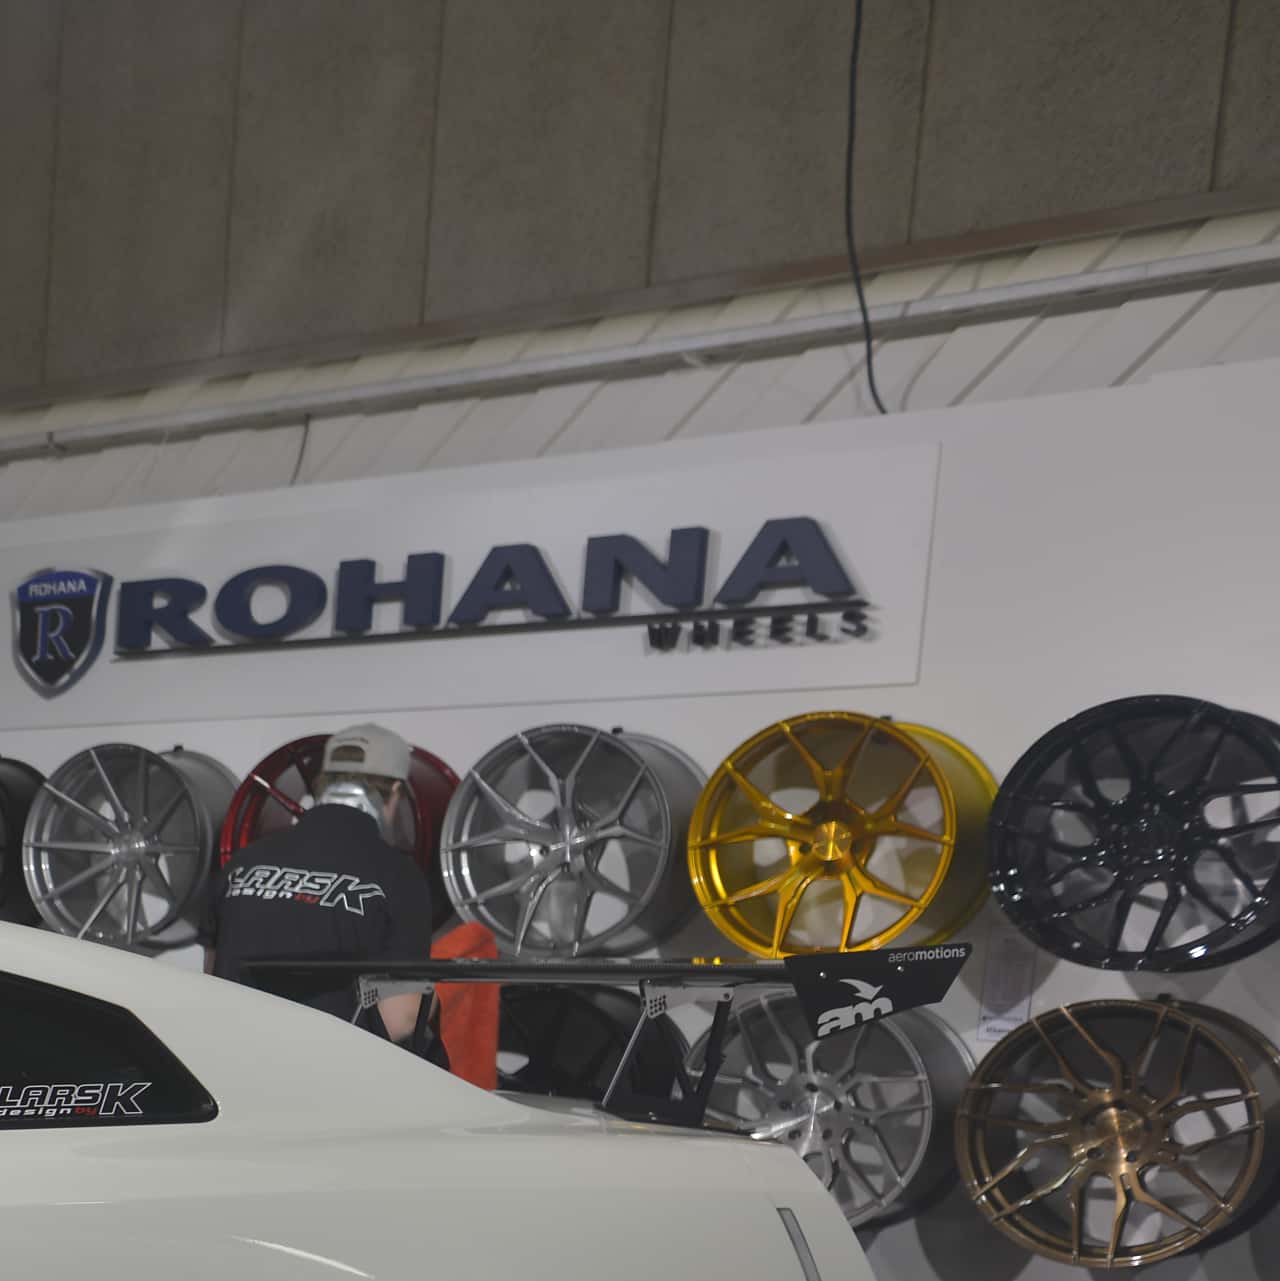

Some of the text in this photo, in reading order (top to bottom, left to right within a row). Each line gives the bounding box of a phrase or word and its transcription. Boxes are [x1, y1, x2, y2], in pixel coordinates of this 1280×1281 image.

[29, 577, 88, 597] ROHANA
[118, 517, 856, 651] ROHANA
[647, 611, 870, 651] WHEELS
[888, 946, 967, 963] aeromotions
